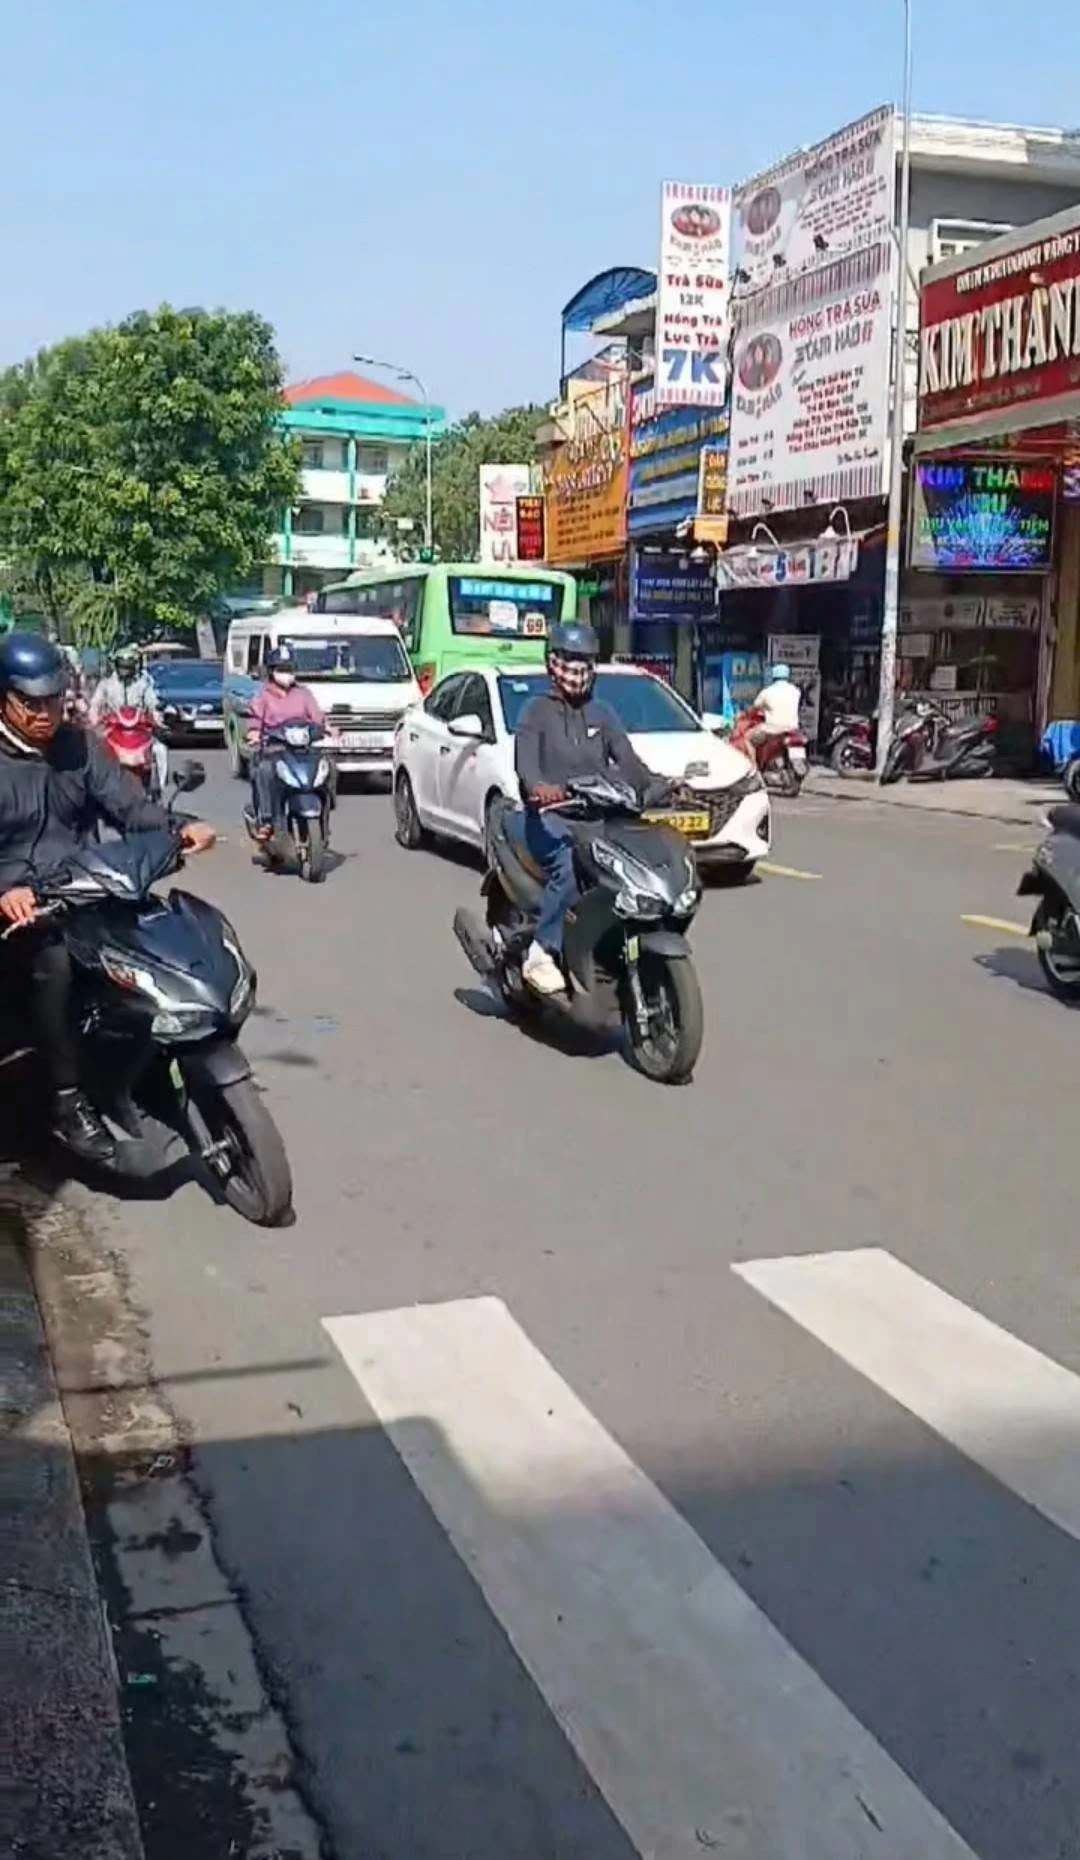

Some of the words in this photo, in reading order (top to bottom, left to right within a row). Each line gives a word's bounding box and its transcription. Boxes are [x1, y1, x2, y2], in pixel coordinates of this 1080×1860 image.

[666, 273, 690, 287] Trà
[662, 348, 720, 384] 7K
[919, 312, 974, 397] KIM
